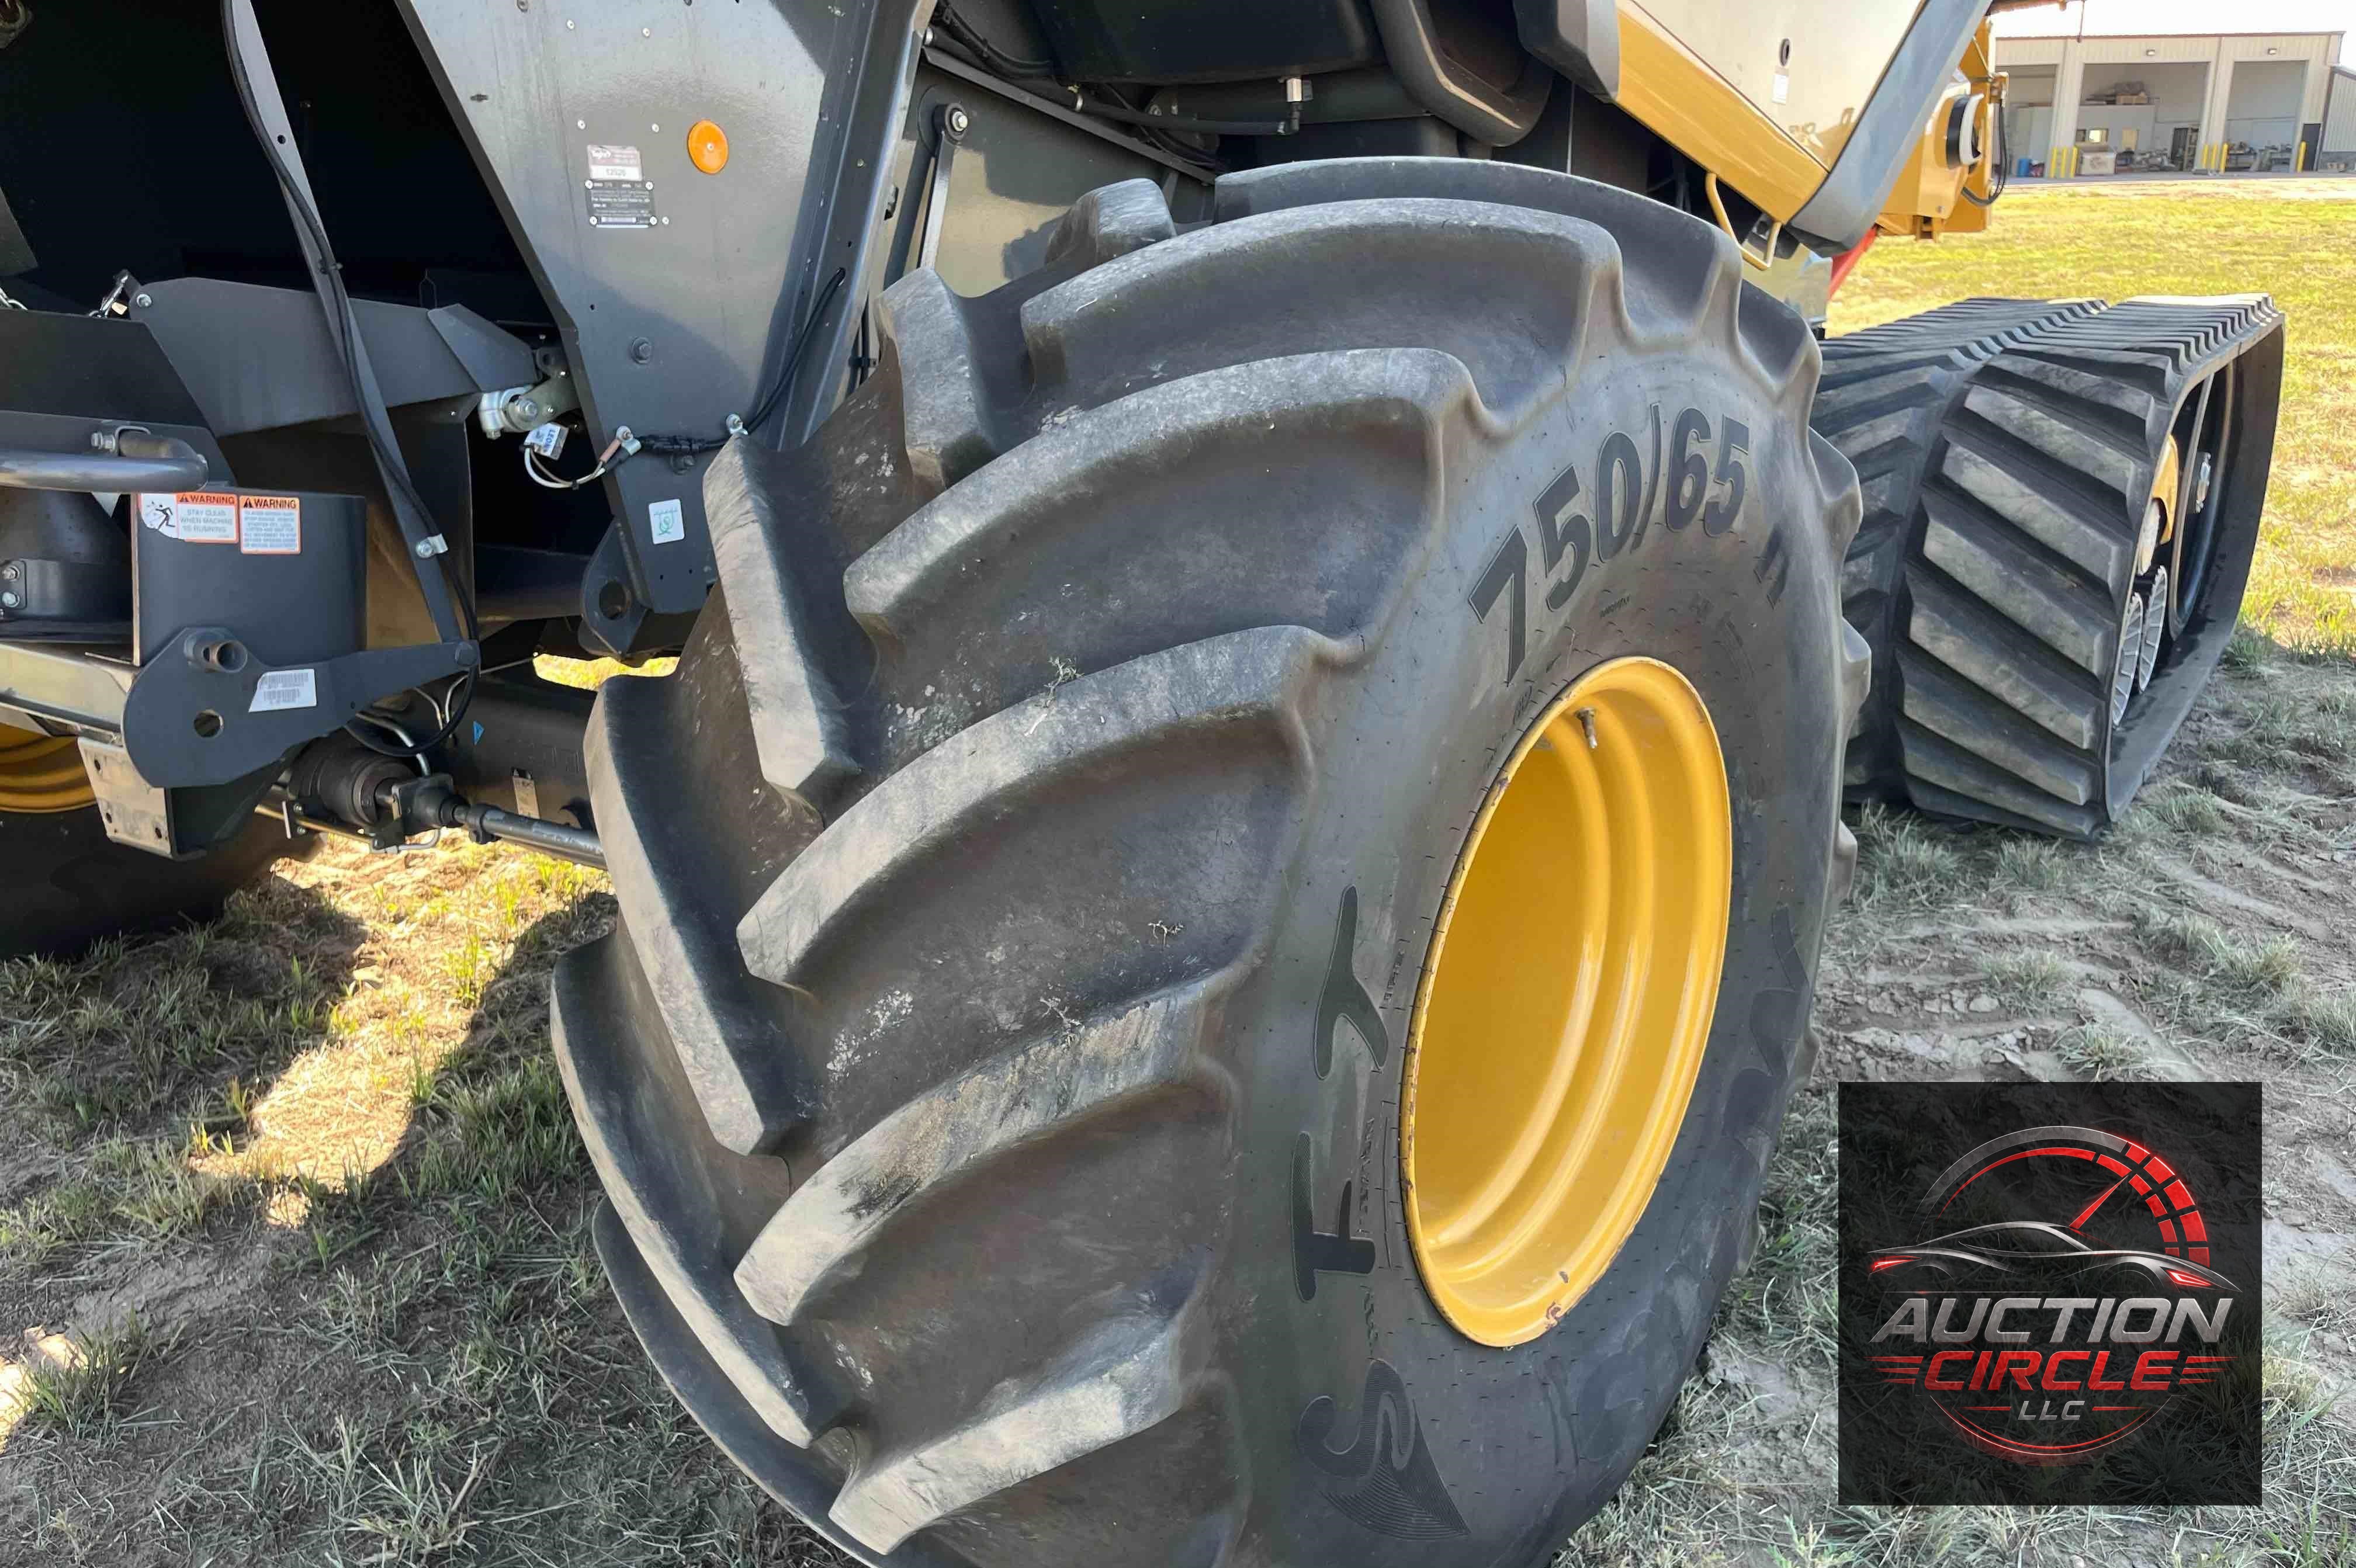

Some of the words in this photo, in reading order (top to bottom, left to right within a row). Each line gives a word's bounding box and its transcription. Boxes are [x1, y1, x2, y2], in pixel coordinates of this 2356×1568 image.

[190, 495, 235, 504] WARNING
[254, 498, 296, 509] WARNING
[1468, 402, 1749, 688] 750/65
